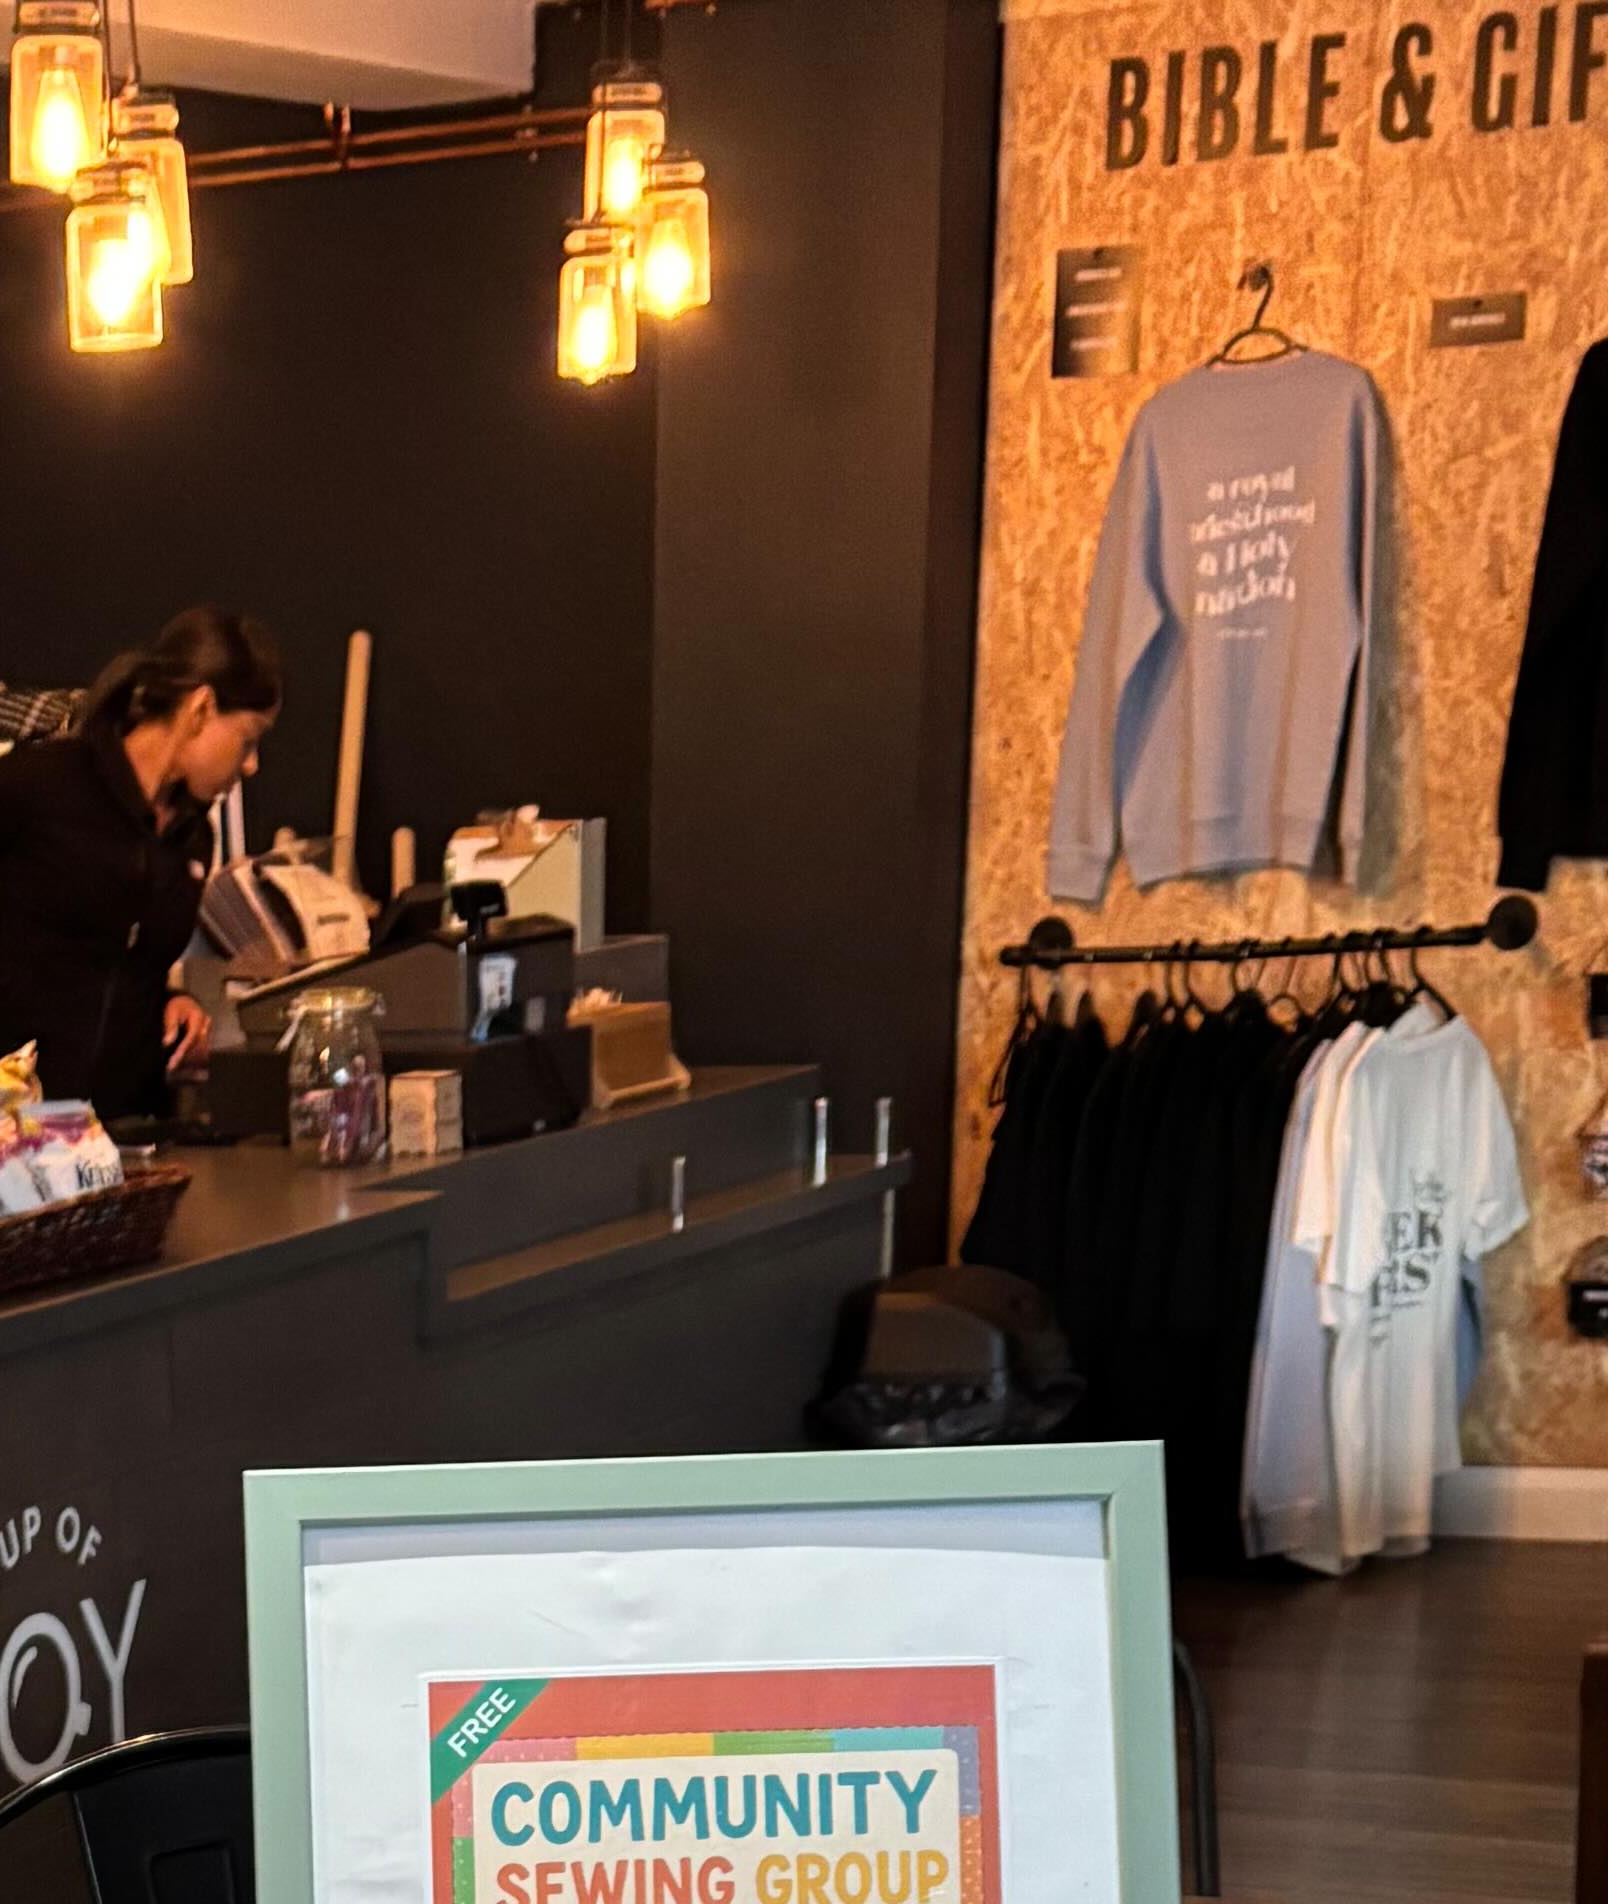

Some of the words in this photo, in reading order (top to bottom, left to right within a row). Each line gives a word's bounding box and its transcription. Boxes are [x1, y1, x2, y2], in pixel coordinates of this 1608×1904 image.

[1105, 31, 1347, 171] BIBLE
[1378, 23, 1437, 144] &
[1471, 1, 1608, 134] GIF
[54, 1505, 103, 1566] OF
[447, 1687, 516, 1758] FREE
[492, 1769, 938, 1847] COMMUNITY
